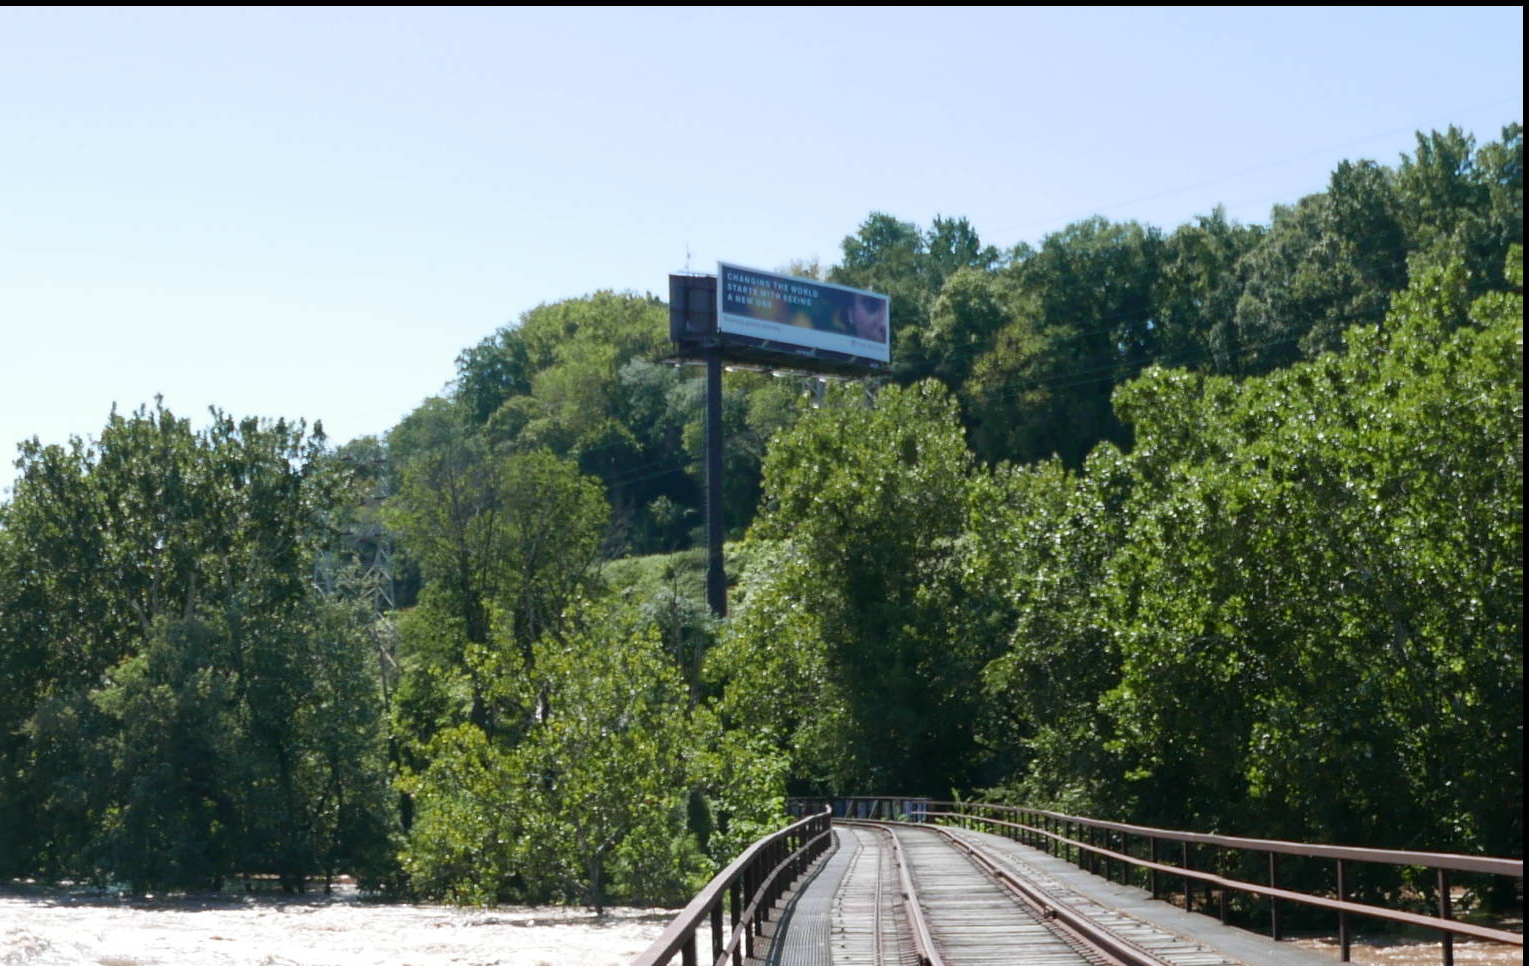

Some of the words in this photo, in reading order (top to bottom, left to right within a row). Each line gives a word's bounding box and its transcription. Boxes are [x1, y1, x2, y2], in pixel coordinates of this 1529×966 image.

[727, 272, 771, 288] CHANGING
[773, 281, 788, 292] THE
[790, 285, 819, 298] WORLD
[727, 282, 758, 296] STARTS
[760, 289, 781, 300] WITH
[783, 294, 812, 306] SEEING
[735, 295, 753, 304] NEW
